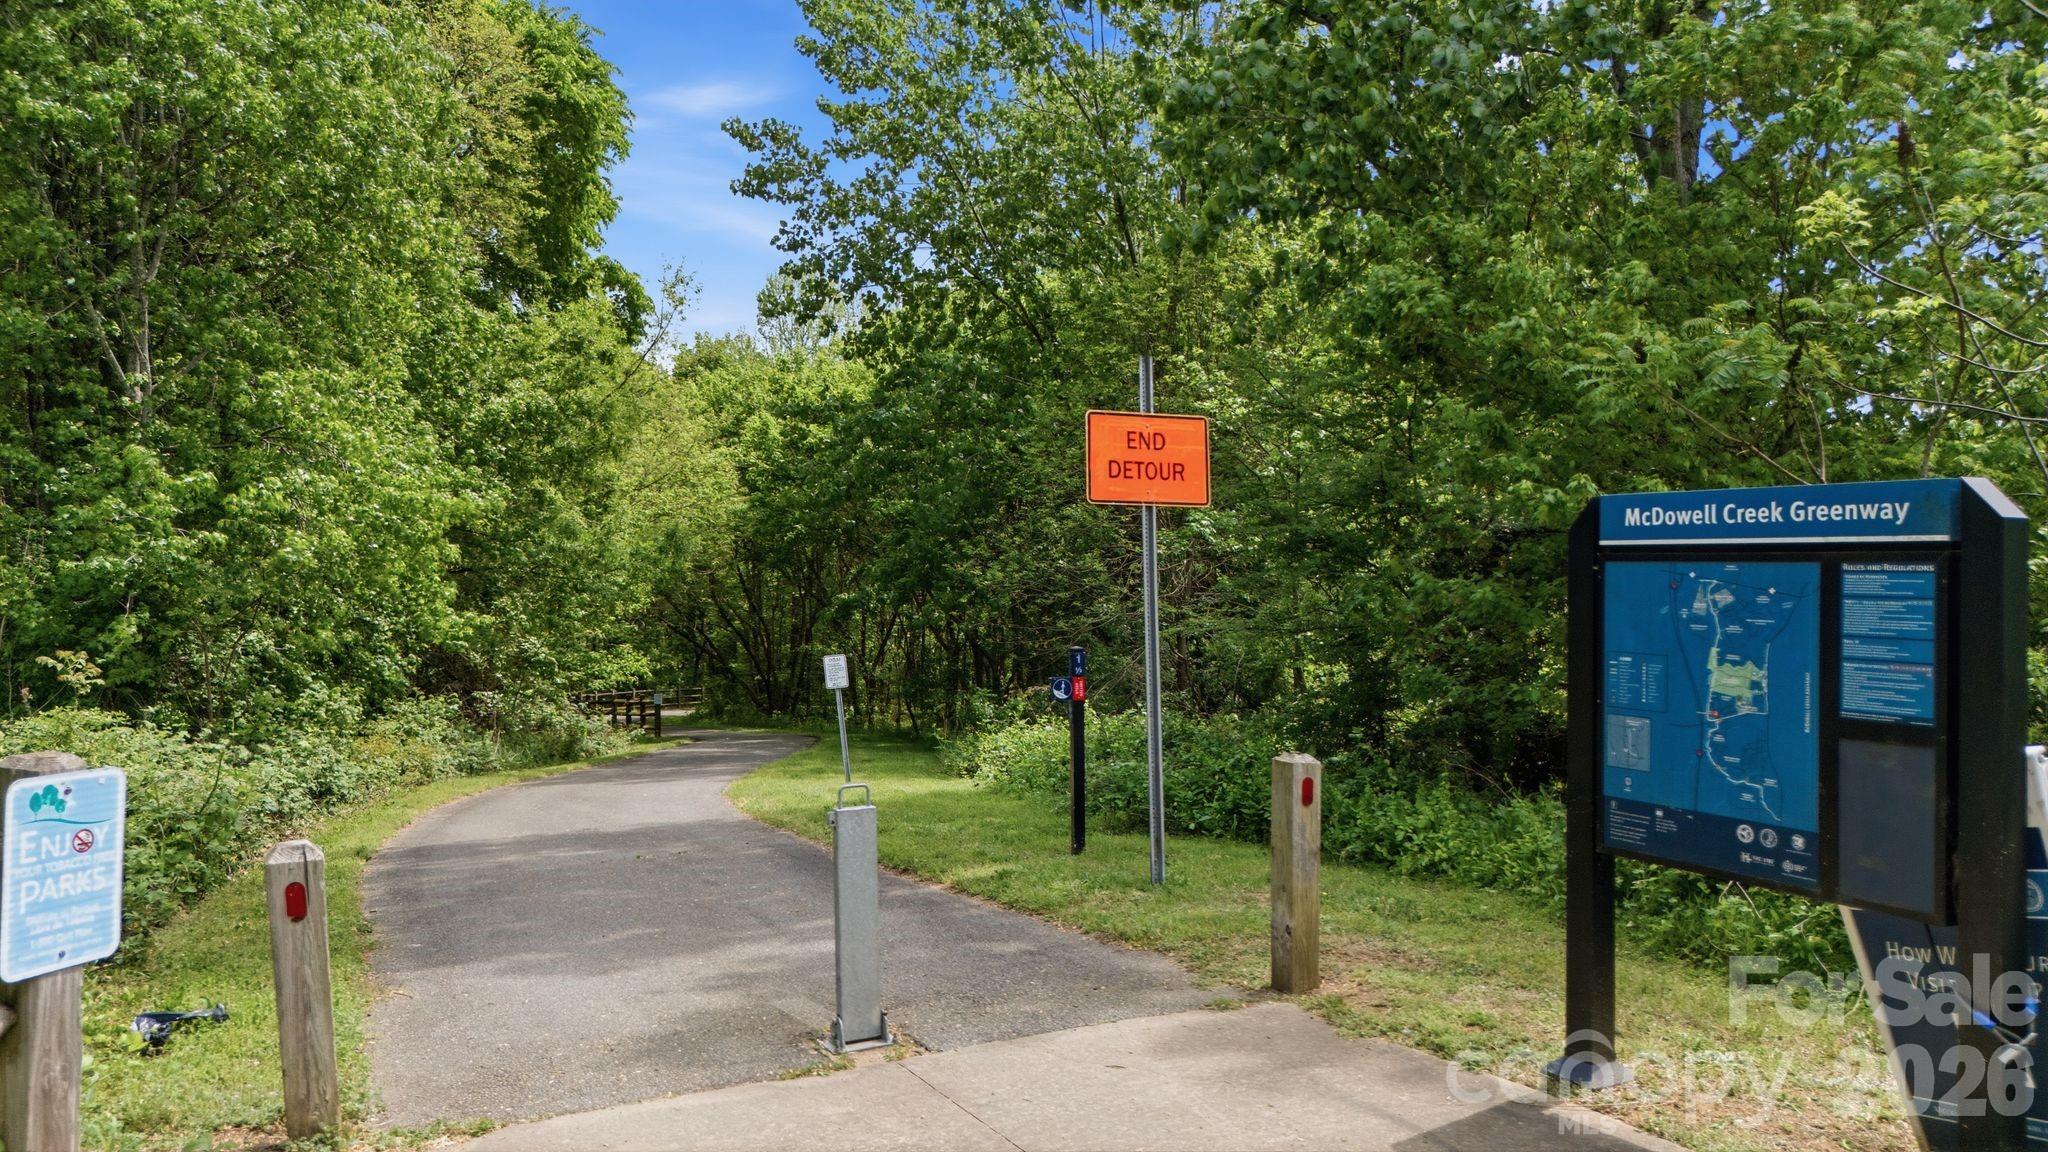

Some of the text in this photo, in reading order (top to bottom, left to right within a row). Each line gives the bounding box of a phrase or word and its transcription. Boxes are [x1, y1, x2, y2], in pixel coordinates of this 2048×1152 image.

[1126, 431, 1166, 451] END
[1108, 460, 1185, 481] DETOUR
[1624, 501, 1910, 527] McDowell Creek Greenway
[19, 866, 107, 914] PARKS
